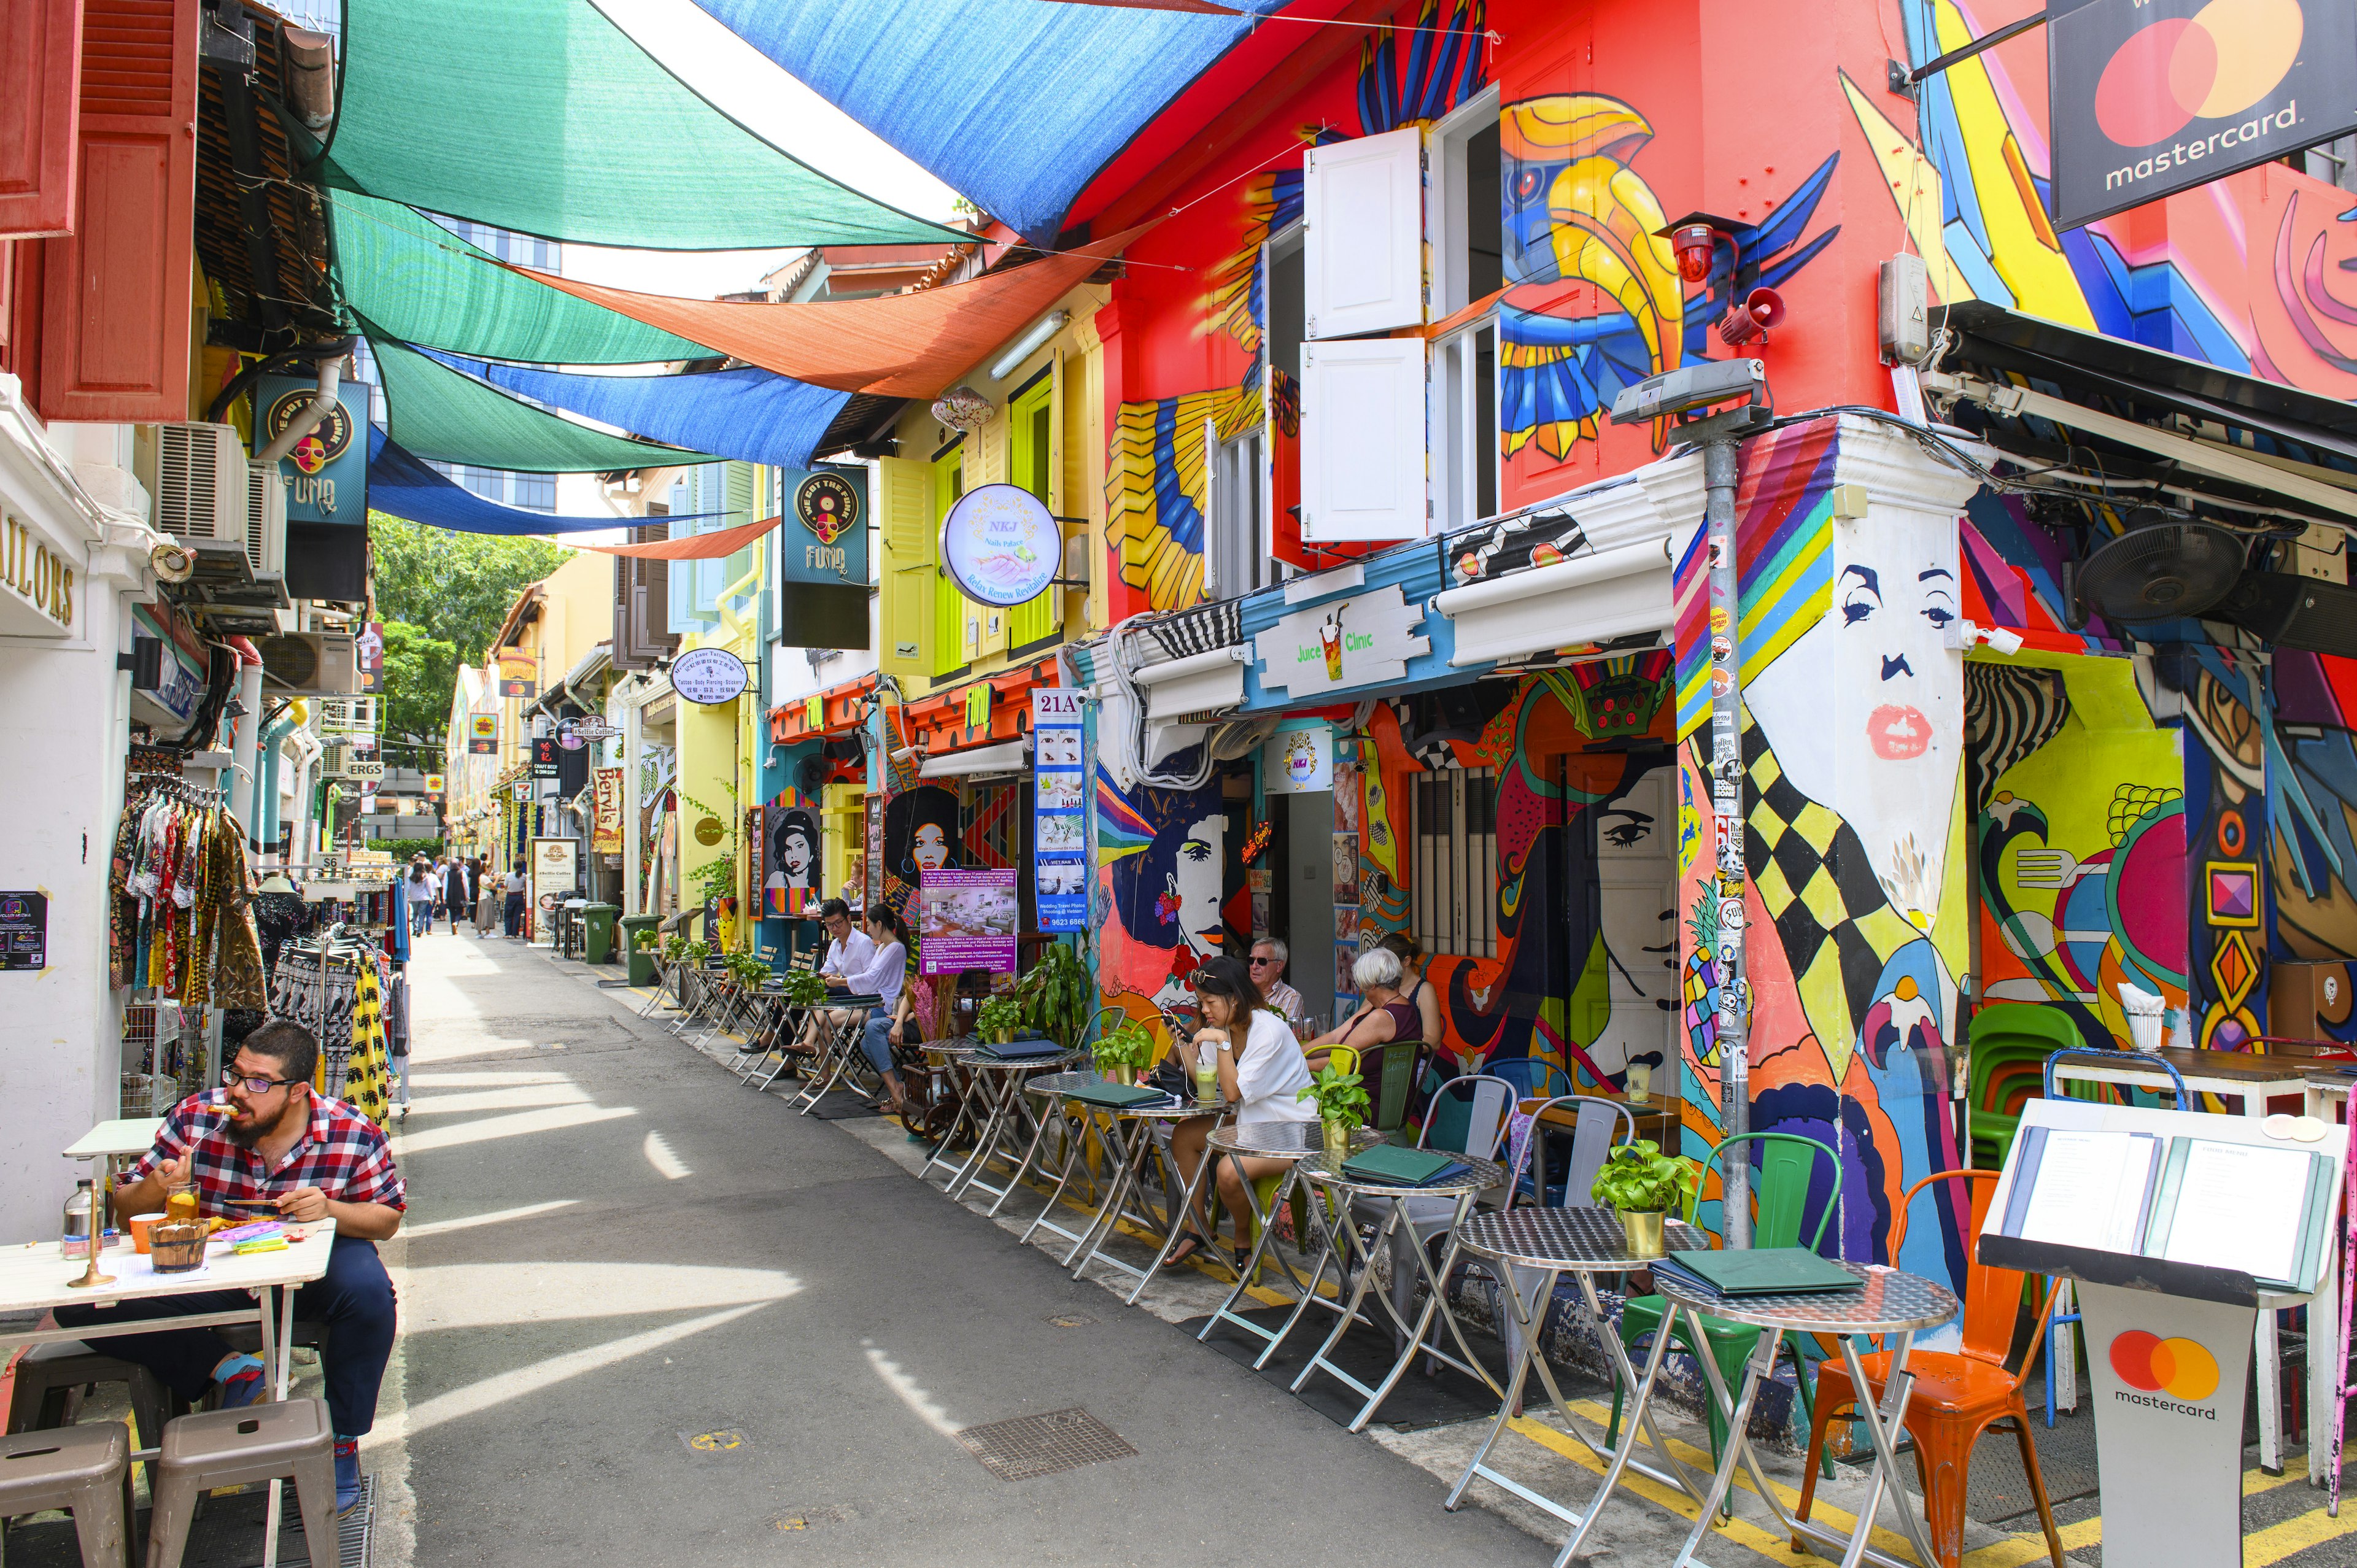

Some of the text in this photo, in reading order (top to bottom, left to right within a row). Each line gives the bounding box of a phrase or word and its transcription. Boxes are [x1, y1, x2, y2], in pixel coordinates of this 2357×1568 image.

[2106, 99, 2297, 191] mastercard
[281, 399, 303, 424] GOT
[330, 410, 344, 445] FUNK
[803, 480, 851, 519] WE GOT THE FUNK
[989, 521, 1018, 532] NKJ
[985, 538, 1002, 547] Nails
[0, 506, 73, 625] ILORS
[805, 545, 848, 575] FUNQ
[967, 572, 1048, 599] Relax Renew Revitalize
[1297, 632, 1373, 663] Juice Clinic
[675, 656, 694, 674] Memory
[709, 651, 727, 660] Tattoo
[729, 657, 745, 675] Studio
[806, 695, 825, 732] FUNQ
[964, 682, 993, 733] FUNQ
[1041, 695, 1077, 713] 21A
[1292, 758, 1308, 769] NKJ
[1727, 761, 1741, 776] 16
[596, 768, 617, 824] Beryl's
[1242, 826, 1269, 860] Nails Open
[324, 859, 337, 867] $6
[2115, 1388, 2216, 1421] mastercard
